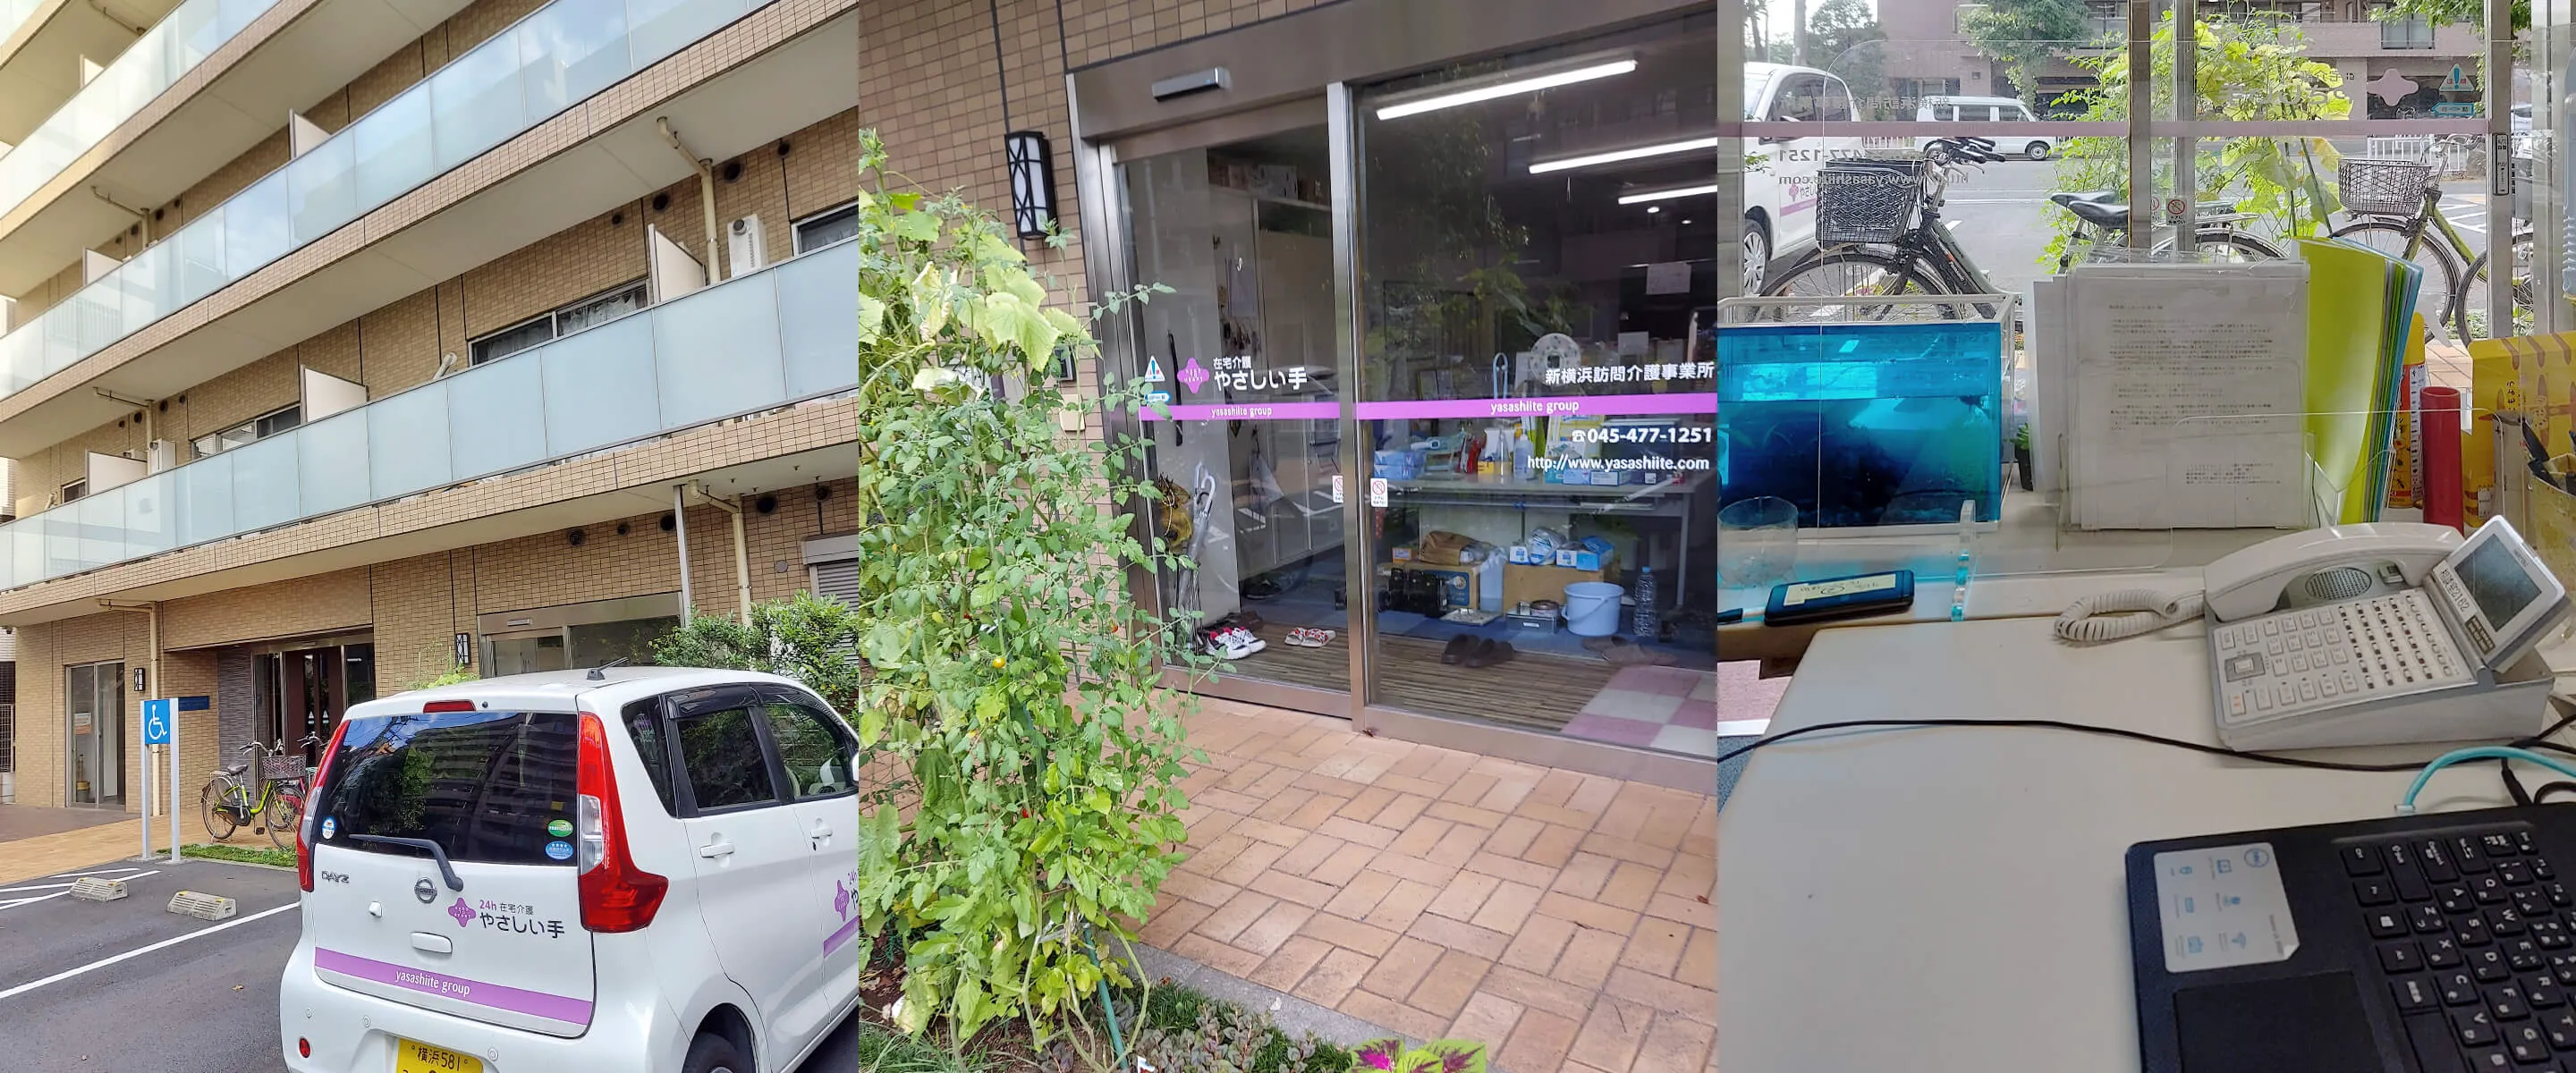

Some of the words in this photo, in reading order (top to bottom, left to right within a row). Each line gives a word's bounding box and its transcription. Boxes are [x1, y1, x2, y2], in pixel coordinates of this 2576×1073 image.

[1213, 355, 1251, 369] 在宅介護
[1214, 367, 1308, 391] やさしい手
[1545, 361, 1715, 384] 新横浜訪問介護事業所
[1211, 406, 1248, 418] yasashiite
[1250, 406, 1272, 418] group
[1490, 401, 1543, 416] yasashiite
[1546, 401, 1580, 414] group
[1588, 427, 1711, 443] 045-477-1251
[1527, 455, 1709, 472] http://www.yasashiite.com
[479, 900, 497, 911] 24h
[499, 902, 534, 916] 在宅介護
[479, 912, 564, 938] やさしい手
[394, 969, 439, 988] yasashiite
[441, 980, 470, 997] group
